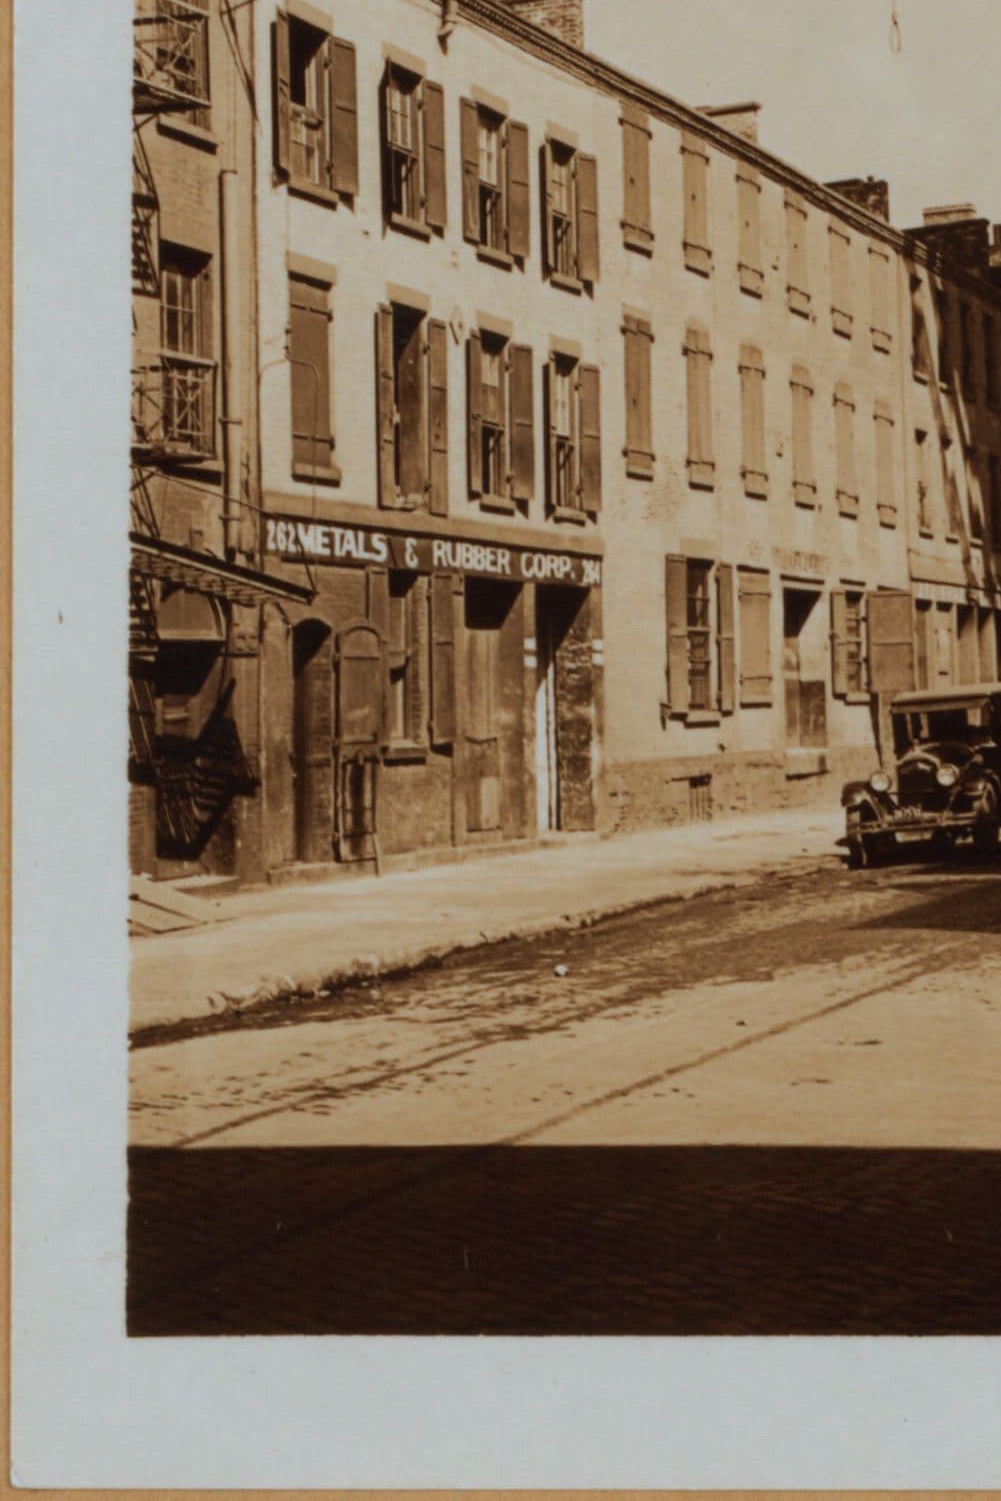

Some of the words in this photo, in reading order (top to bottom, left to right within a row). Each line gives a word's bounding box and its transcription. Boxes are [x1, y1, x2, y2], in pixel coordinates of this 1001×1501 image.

[296, 521, 388, 562] METALS
[432, 540, 511, 575] RUBBER
[520, 552, 576, 581] CORP.
